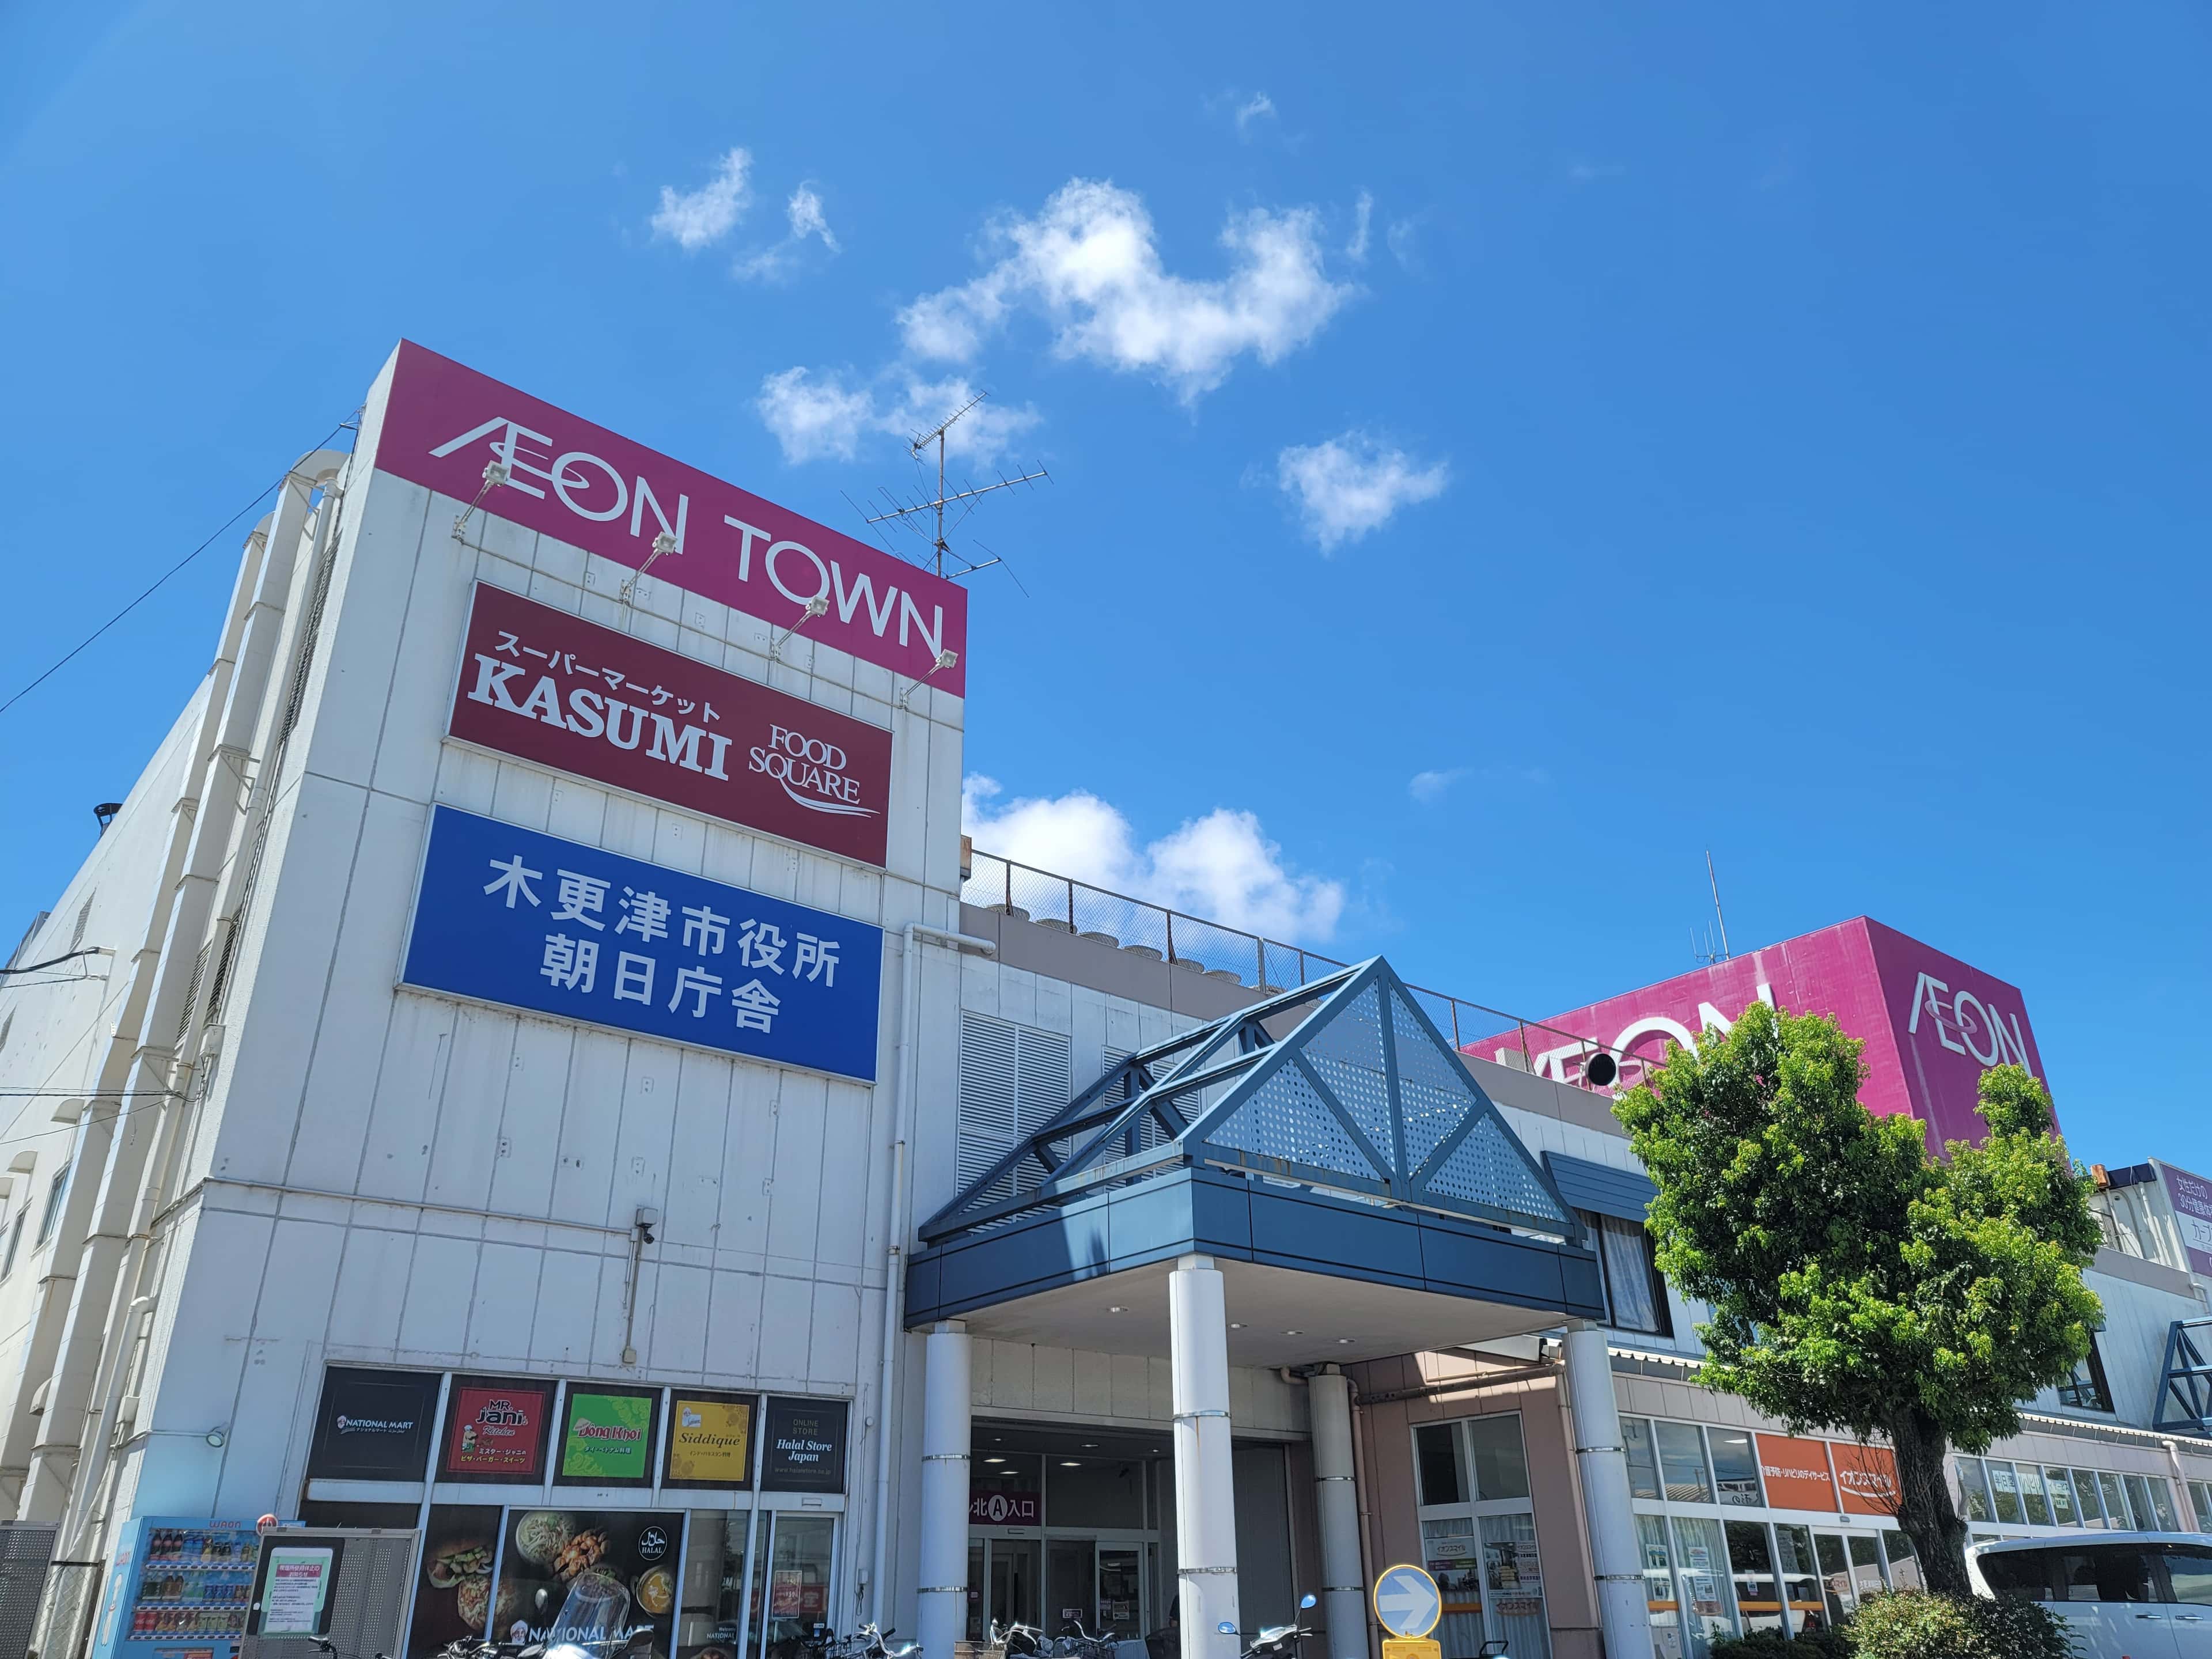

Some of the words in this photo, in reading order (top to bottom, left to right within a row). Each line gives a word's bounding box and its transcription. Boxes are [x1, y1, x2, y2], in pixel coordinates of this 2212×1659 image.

[724, 514, 943, 659] TOWN
[495, 631, 720, 724] スーパーマーケット
[467, 653, 732, 781] KASUMI
[768, 724, 847, 771] FOOD
[749, 747, 863, 808] SQUARE
[483, 855, 841, 988] 木更津市役所
[540, 934, 781, 1034] 朝日庁舎
[489, 1399, 513, 1411] MR.
[346, 1419, 387, 1428] NATIONAL
[793, 1419, 819, 1427] ONLINE
[793, 1427, 819, 1435] STORE
[679, 1433, 740, 1448] Siddique
[777, 1439, 805, 1450] Halal
[806, 1441, 832, 1451] Store
[789, 1451, 819, 1463] Japan
[969, 1495, 1034, 1521] 北A入口
